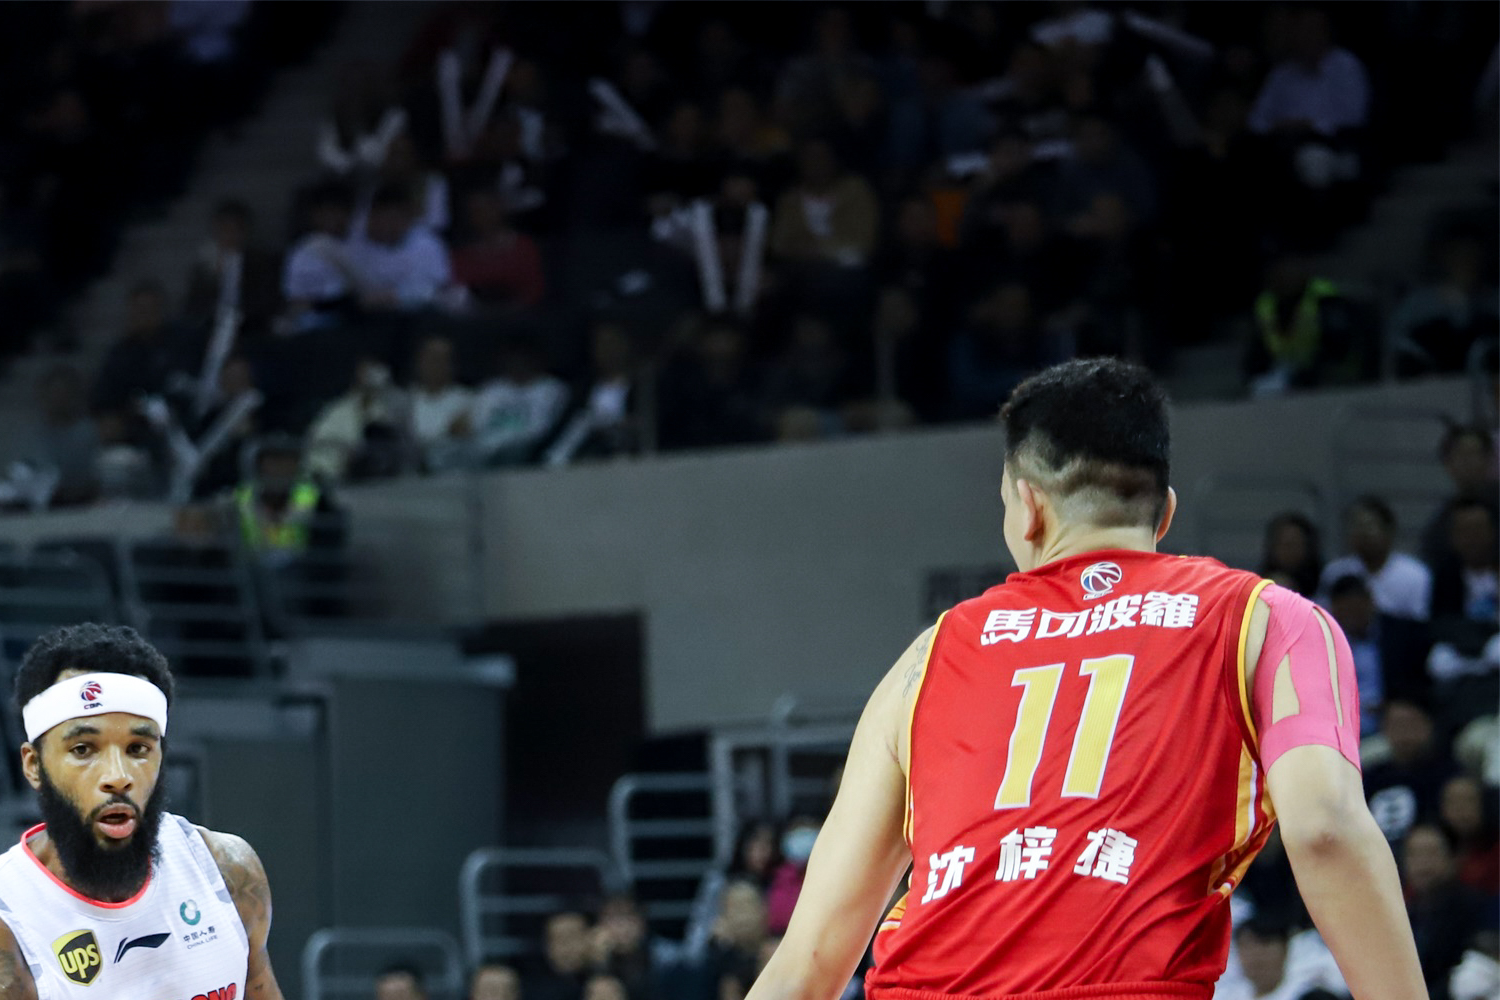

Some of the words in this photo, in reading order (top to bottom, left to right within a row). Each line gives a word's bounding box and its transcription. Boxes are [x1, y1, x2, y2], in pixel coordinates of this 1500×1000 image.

[980, 591, 1199, 646] 馬可波羅
[994, 653, 1135, 811] 11
[921, 825, 1138, 905] 沈梓捷
